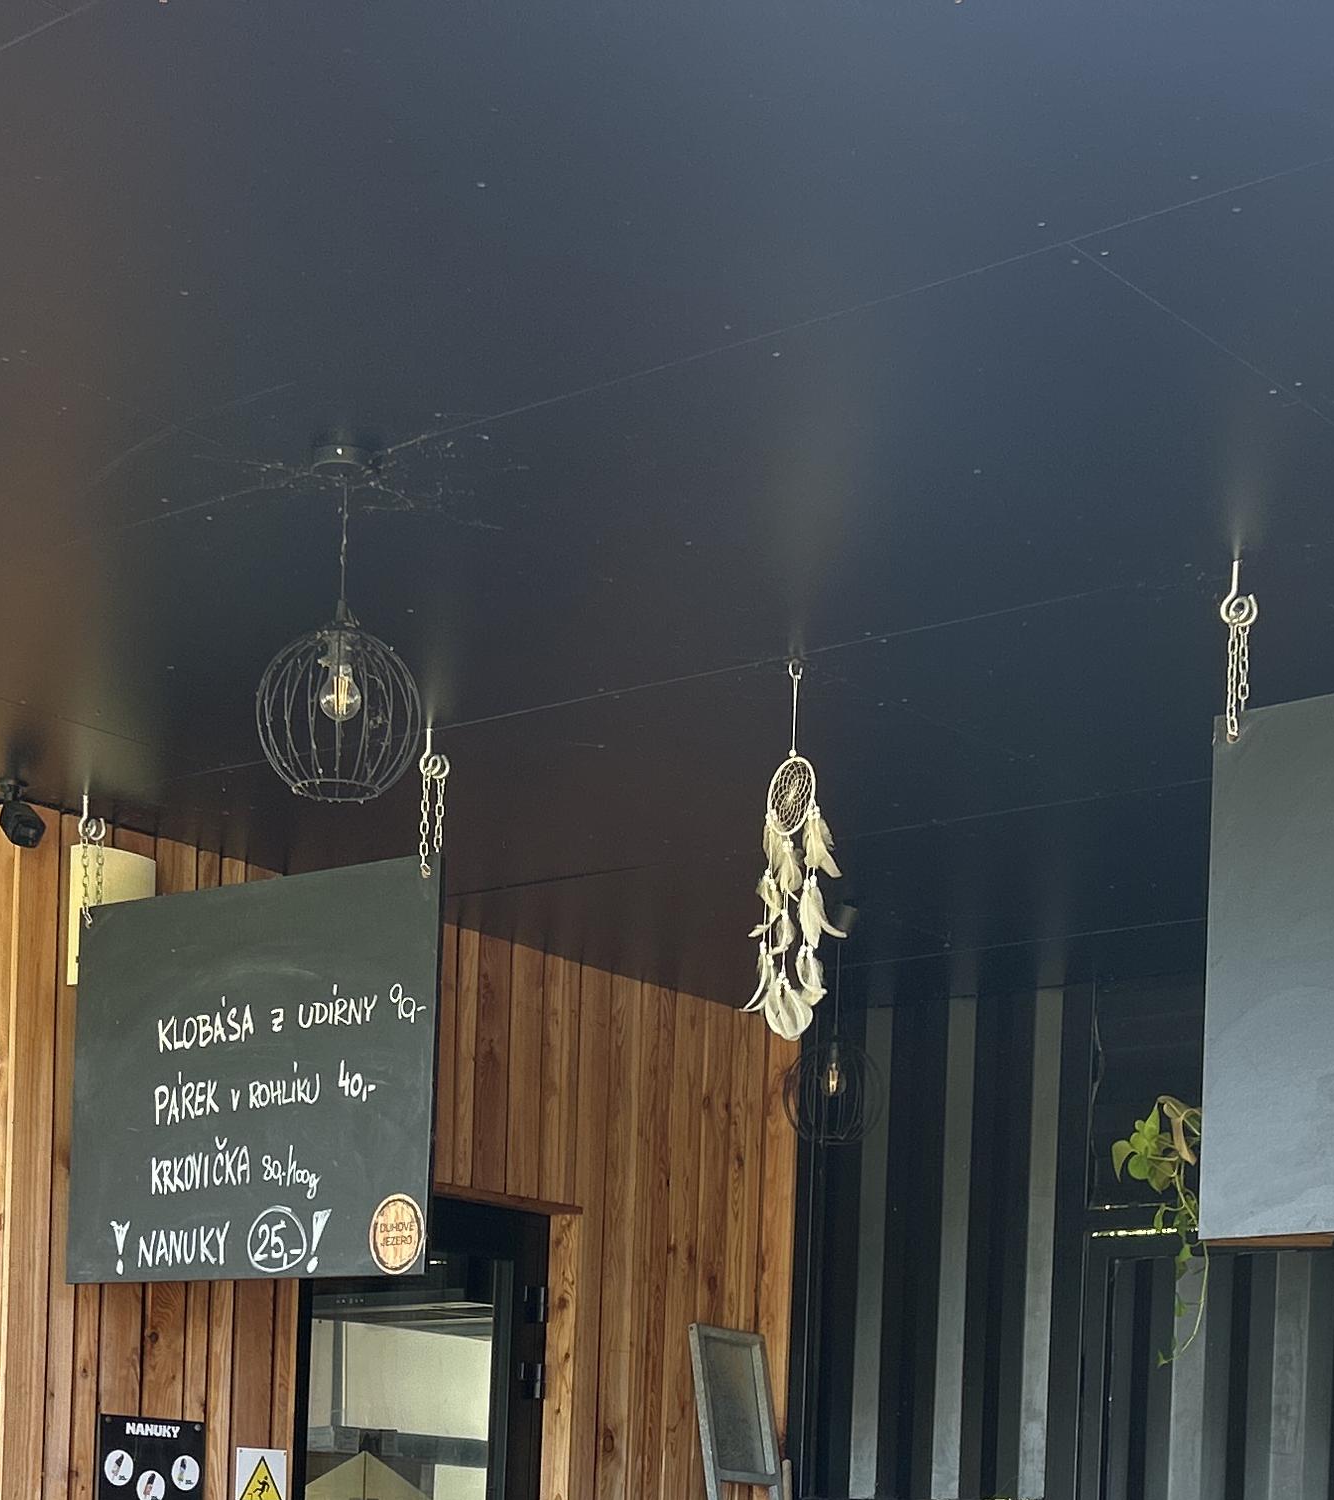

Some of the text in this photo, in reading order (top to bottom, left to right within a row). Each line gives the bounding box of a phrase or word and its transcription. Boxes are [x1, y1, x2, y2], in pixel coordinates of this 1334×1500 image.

[157, 995, 255, 1054] KLOBÁSA
[298, 983, 378, 1029] UDÍRNY
[153, 1071, 220, 1126] PÁREK
[248, 1061, 321, 1109] ROHLÍKU
[337, 1059, 377, 1102] 40,-
[151, 1135, 251, 1195] KRKOVIČKA
[136, 1220, 231, 1268] NANUKY
[380, 1233, 414, 1247] JEZERO
[125, 1422, 181, 1439] NANUKY
